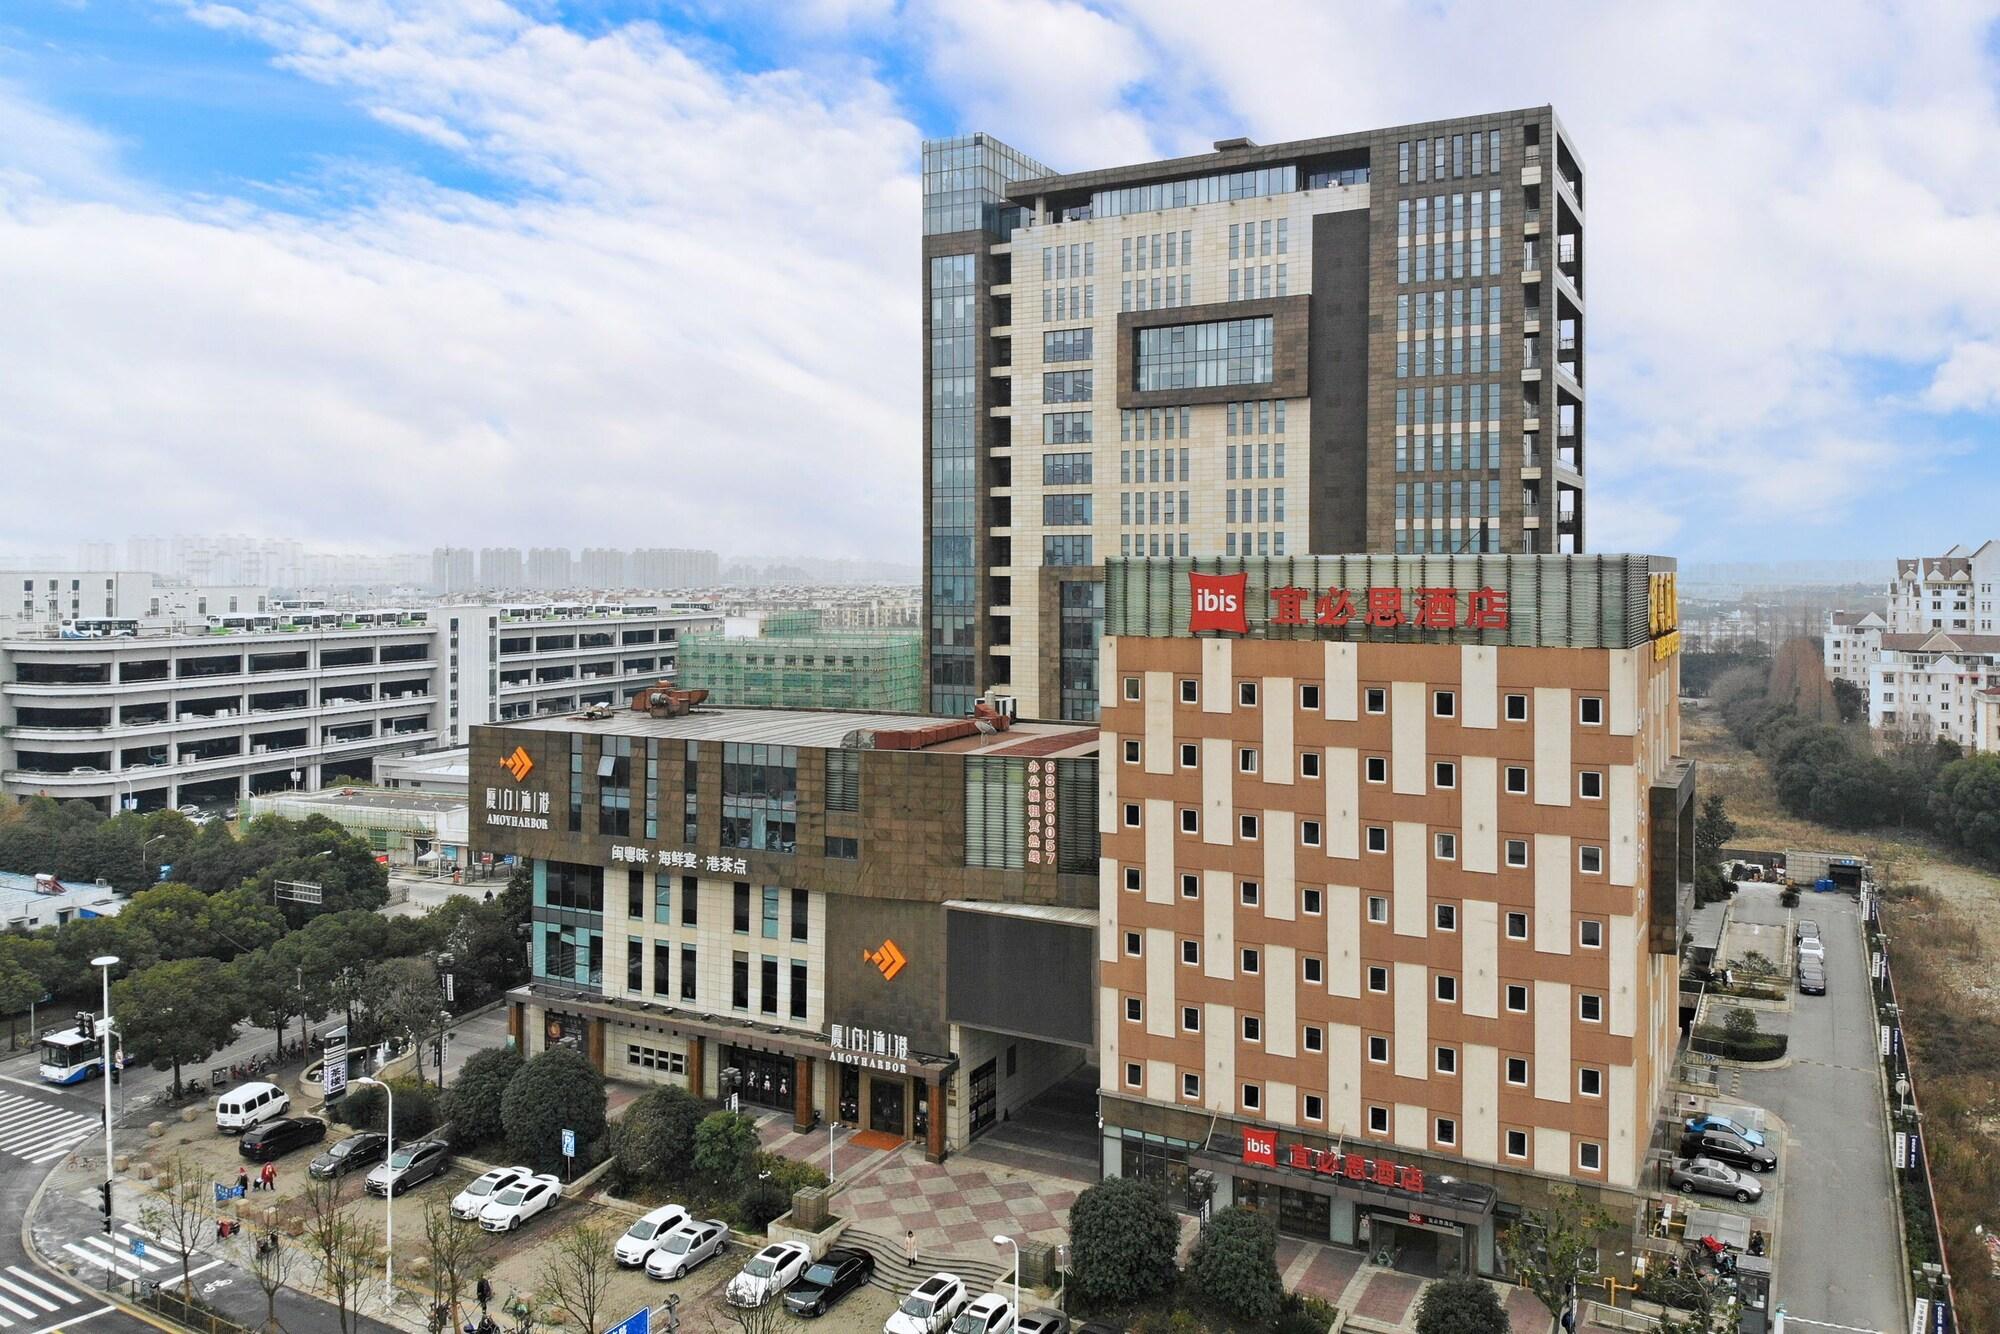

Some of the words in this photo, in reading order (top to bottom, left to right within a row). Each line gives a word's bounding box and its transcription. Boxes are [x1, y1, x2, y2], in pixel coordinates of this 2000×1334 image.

[1197, 588, 1237, 612] ibis
[1270, 584, 1507, 629] 宜必思酒店
[486, 813, 549, 830] AMOYHARBOR
[1044, 760, 1056, 865] 68580057
[829, 1051, 907, 1074] AMOYHARBOR
[1247, 1137, 1271, 1156] ibis
[1289, 1144, 1425, 1193] 宜必思酒店
